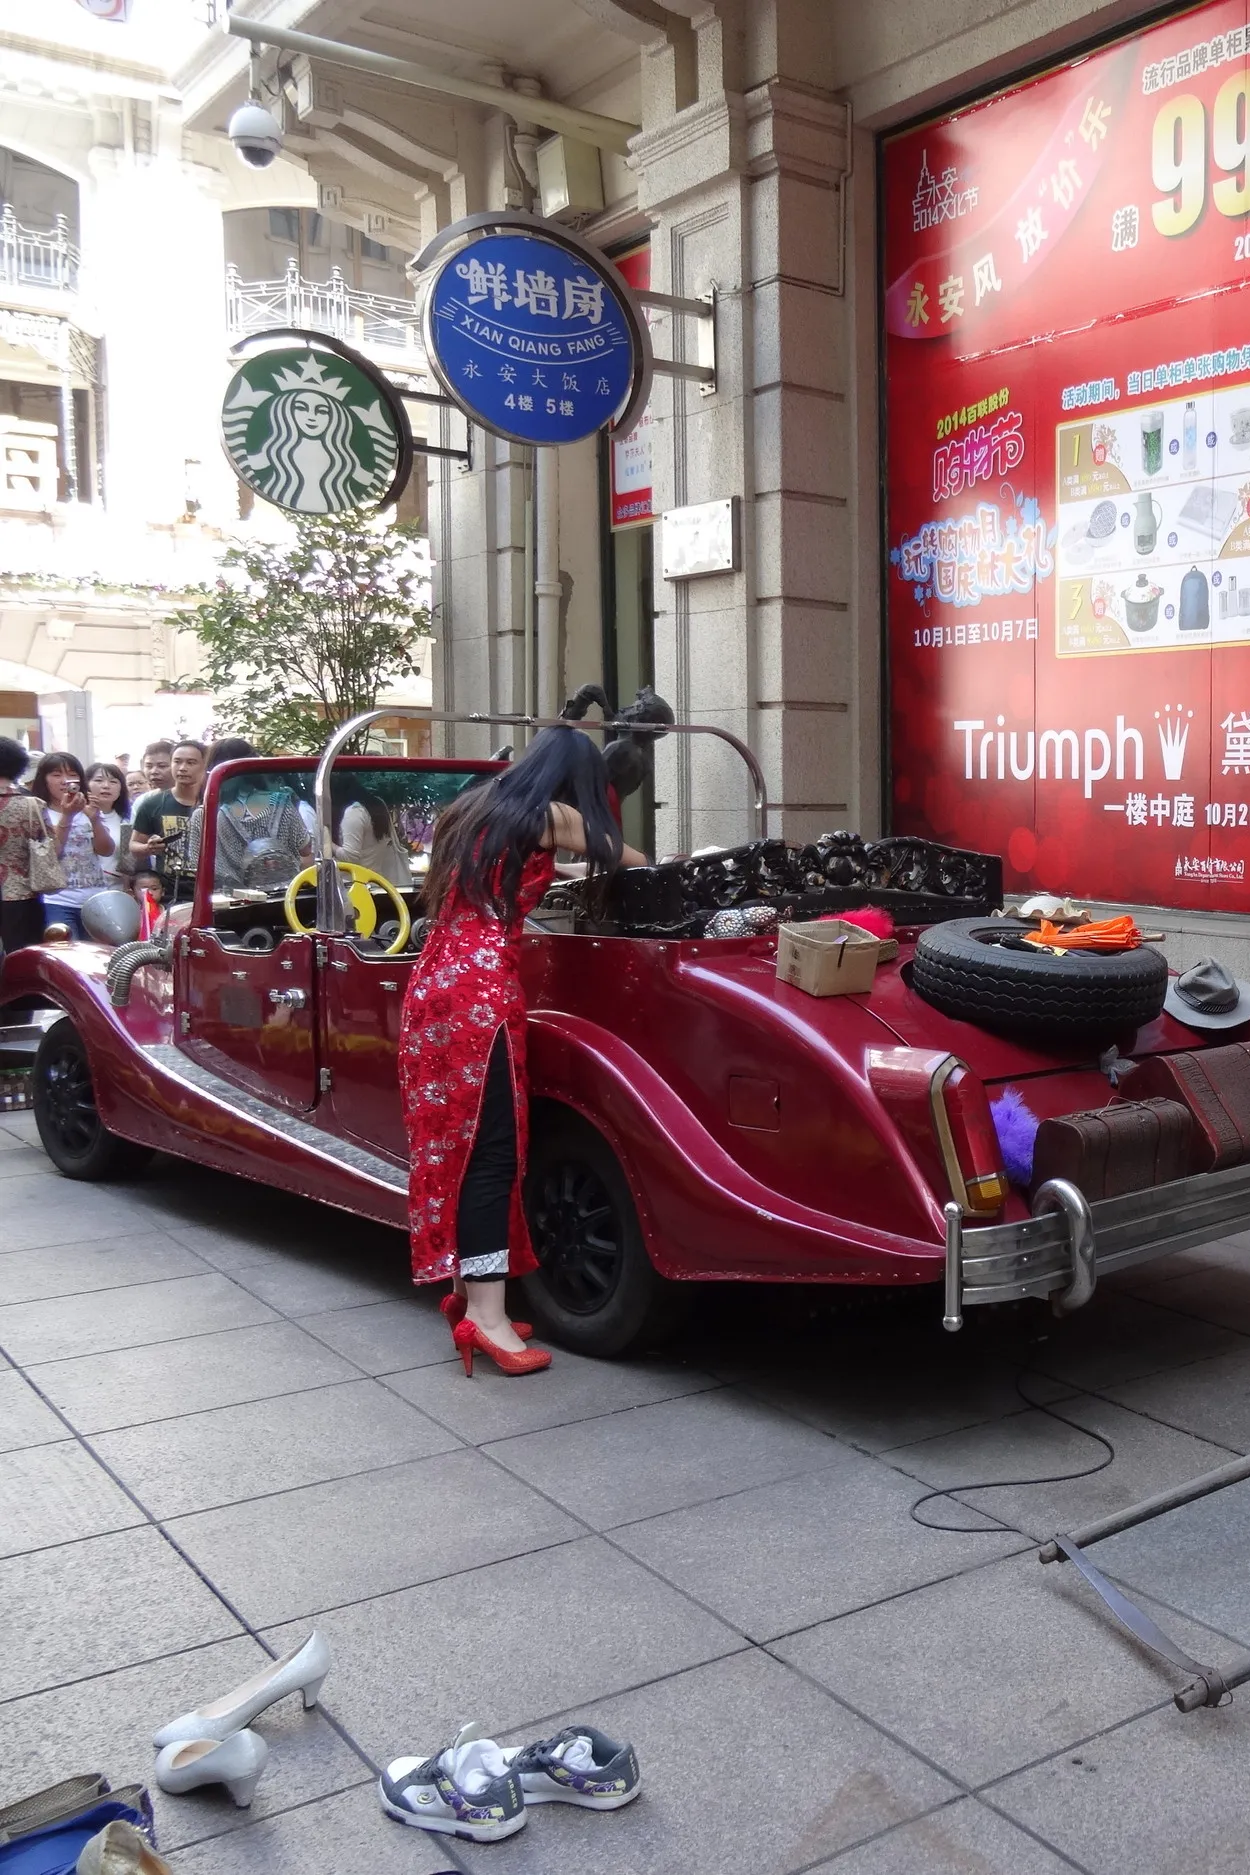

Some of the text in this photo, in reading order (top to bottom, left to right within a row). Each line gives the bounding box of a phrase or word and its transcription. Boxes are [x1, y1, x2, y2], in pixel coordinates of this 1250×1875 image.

[913, 187, 979, 232] 2014文化节
[460, 315, 605, 356] XIAN QIANG FANG
[462, 360, 610, 395] 永安大饭店
[505, 393, 574, 416] 4楼 5楼
[936, 387, 1009, 440] 2014百联股份
[933, 412, 1024, 502] 购物节
[1072, 434, 1080, 466] 1
[1070, 584, 1083, 620] 3
[914, 618, 1039, 648] 10月1日至10月7日
[953, 714, 1144, 798] Triumph
[1104, 793, 1195, 828] 一楼中庭
